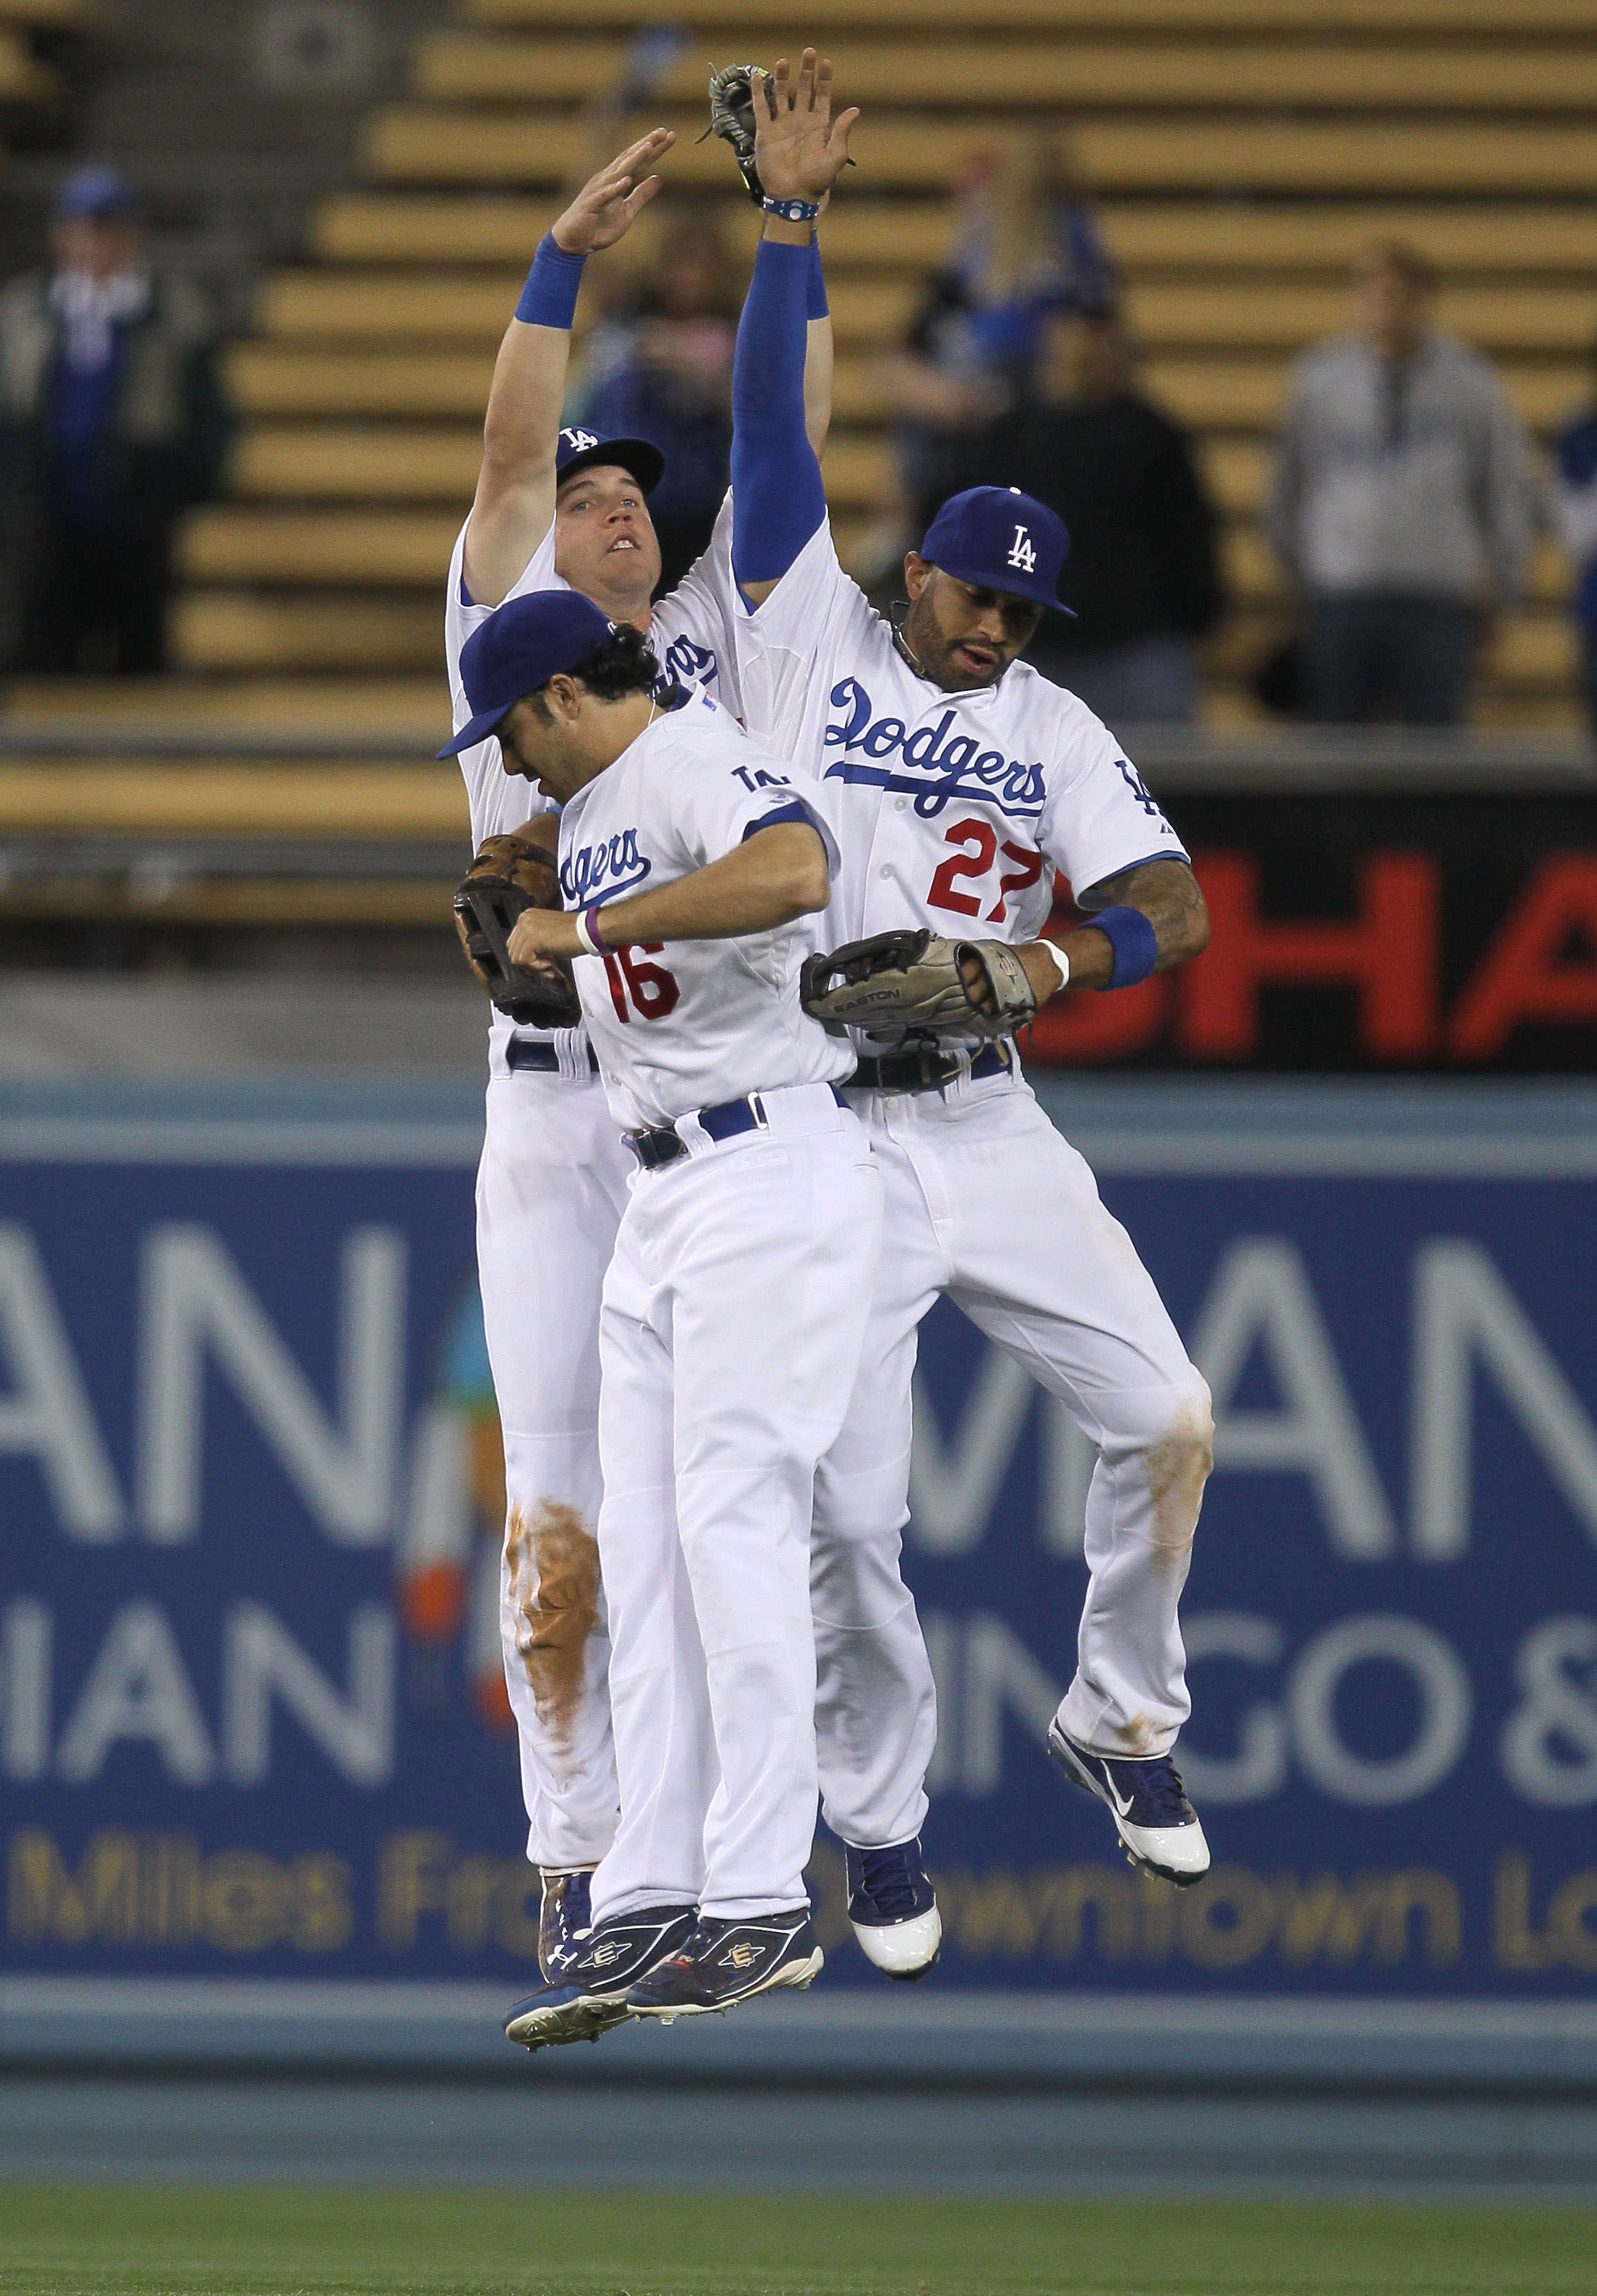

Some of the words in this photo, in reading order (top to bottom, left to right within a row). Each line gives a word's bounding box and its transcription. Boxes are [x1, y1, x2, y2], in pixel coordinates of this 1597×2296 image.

[559, 427, 598, 453] LA
[1007, 525, 1037, 573] LA
[824, 676, 1047, 819] Dodgers
[927, 818, 1042, 923] 27
[602, 941, 681, 1023] 16
[834, 987, 900, 1012] EASTON
[7, 1825, 355, 1952] Miles
